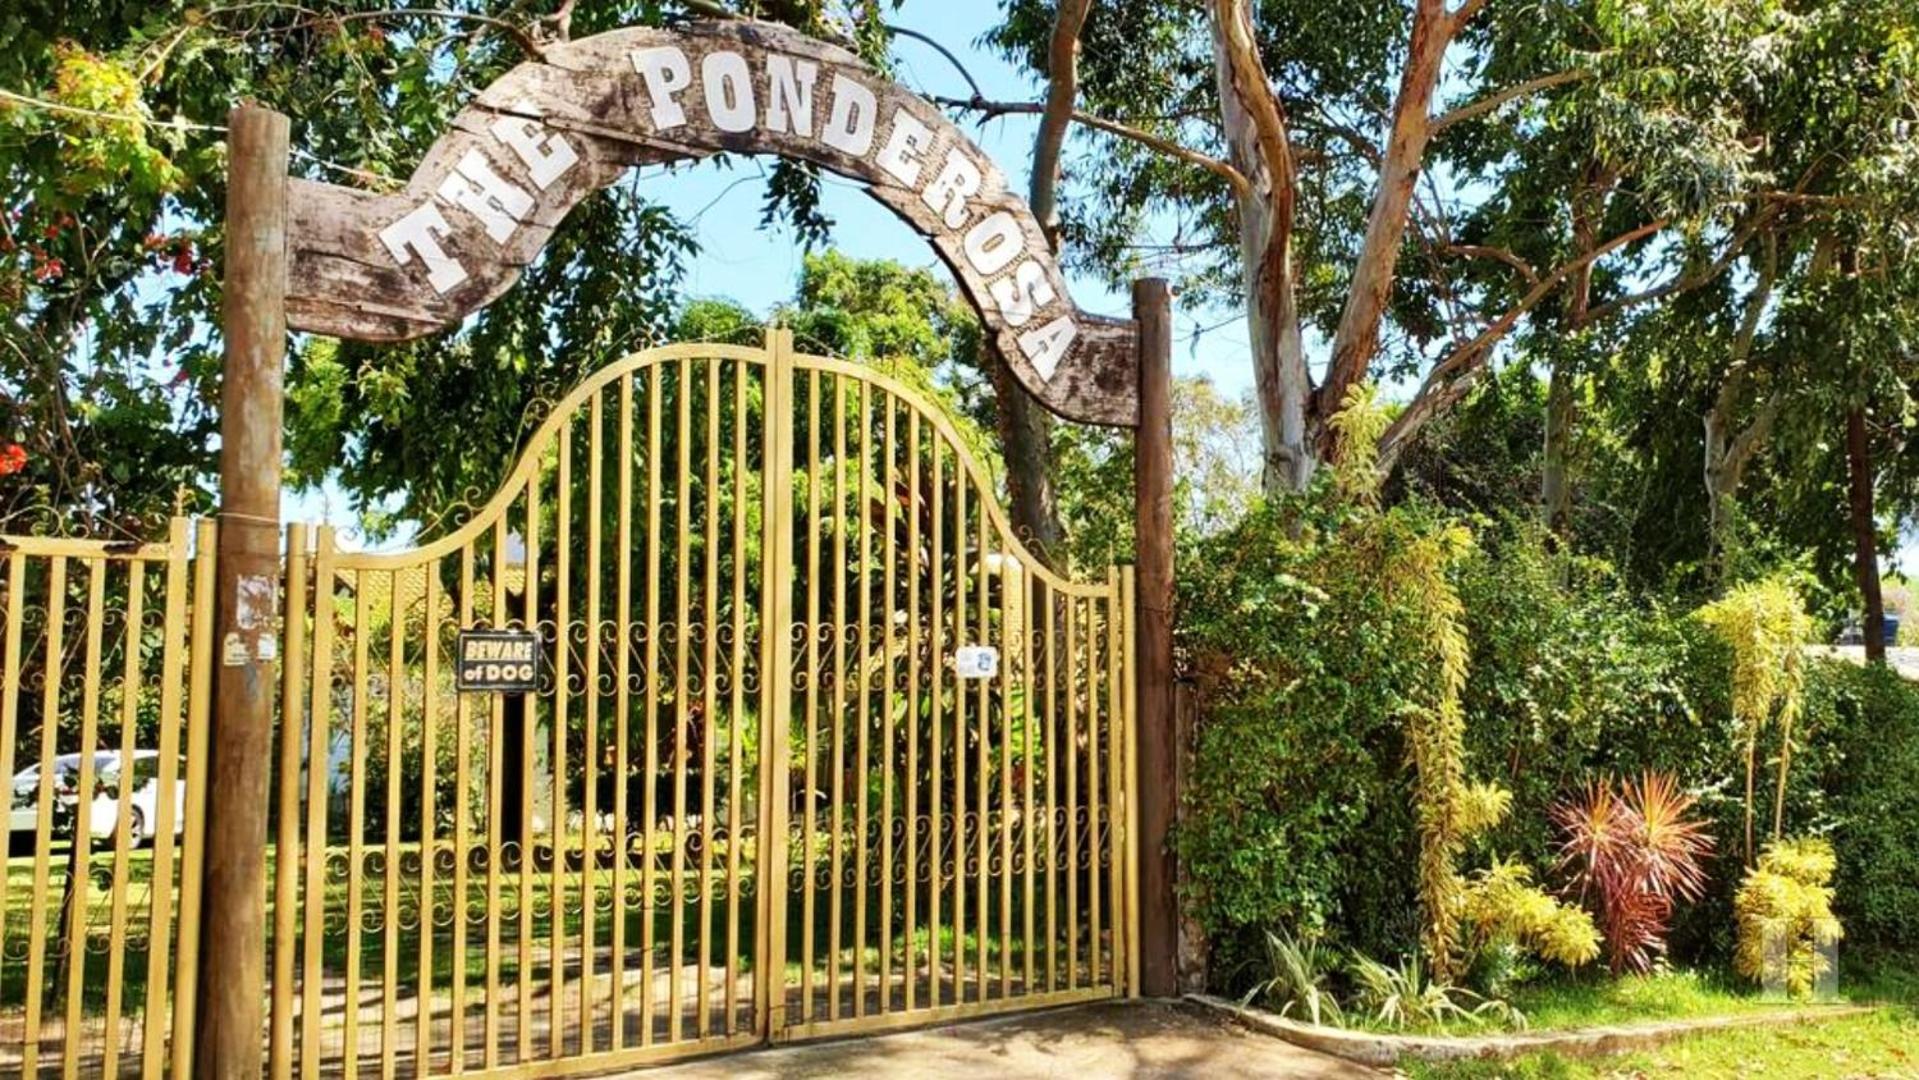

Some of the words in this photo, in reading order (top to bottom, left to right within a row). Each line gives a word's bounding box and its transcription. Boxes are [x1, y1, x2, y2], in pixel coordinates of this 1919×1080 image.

[379, 101, 579, 294] THE
[630, 46, 1077, 382] PONDEROSA
[465, 641, 534, 661] BEWARE
[464, 665, 484, 681] of
[486, 665, 534, 681] DOG
